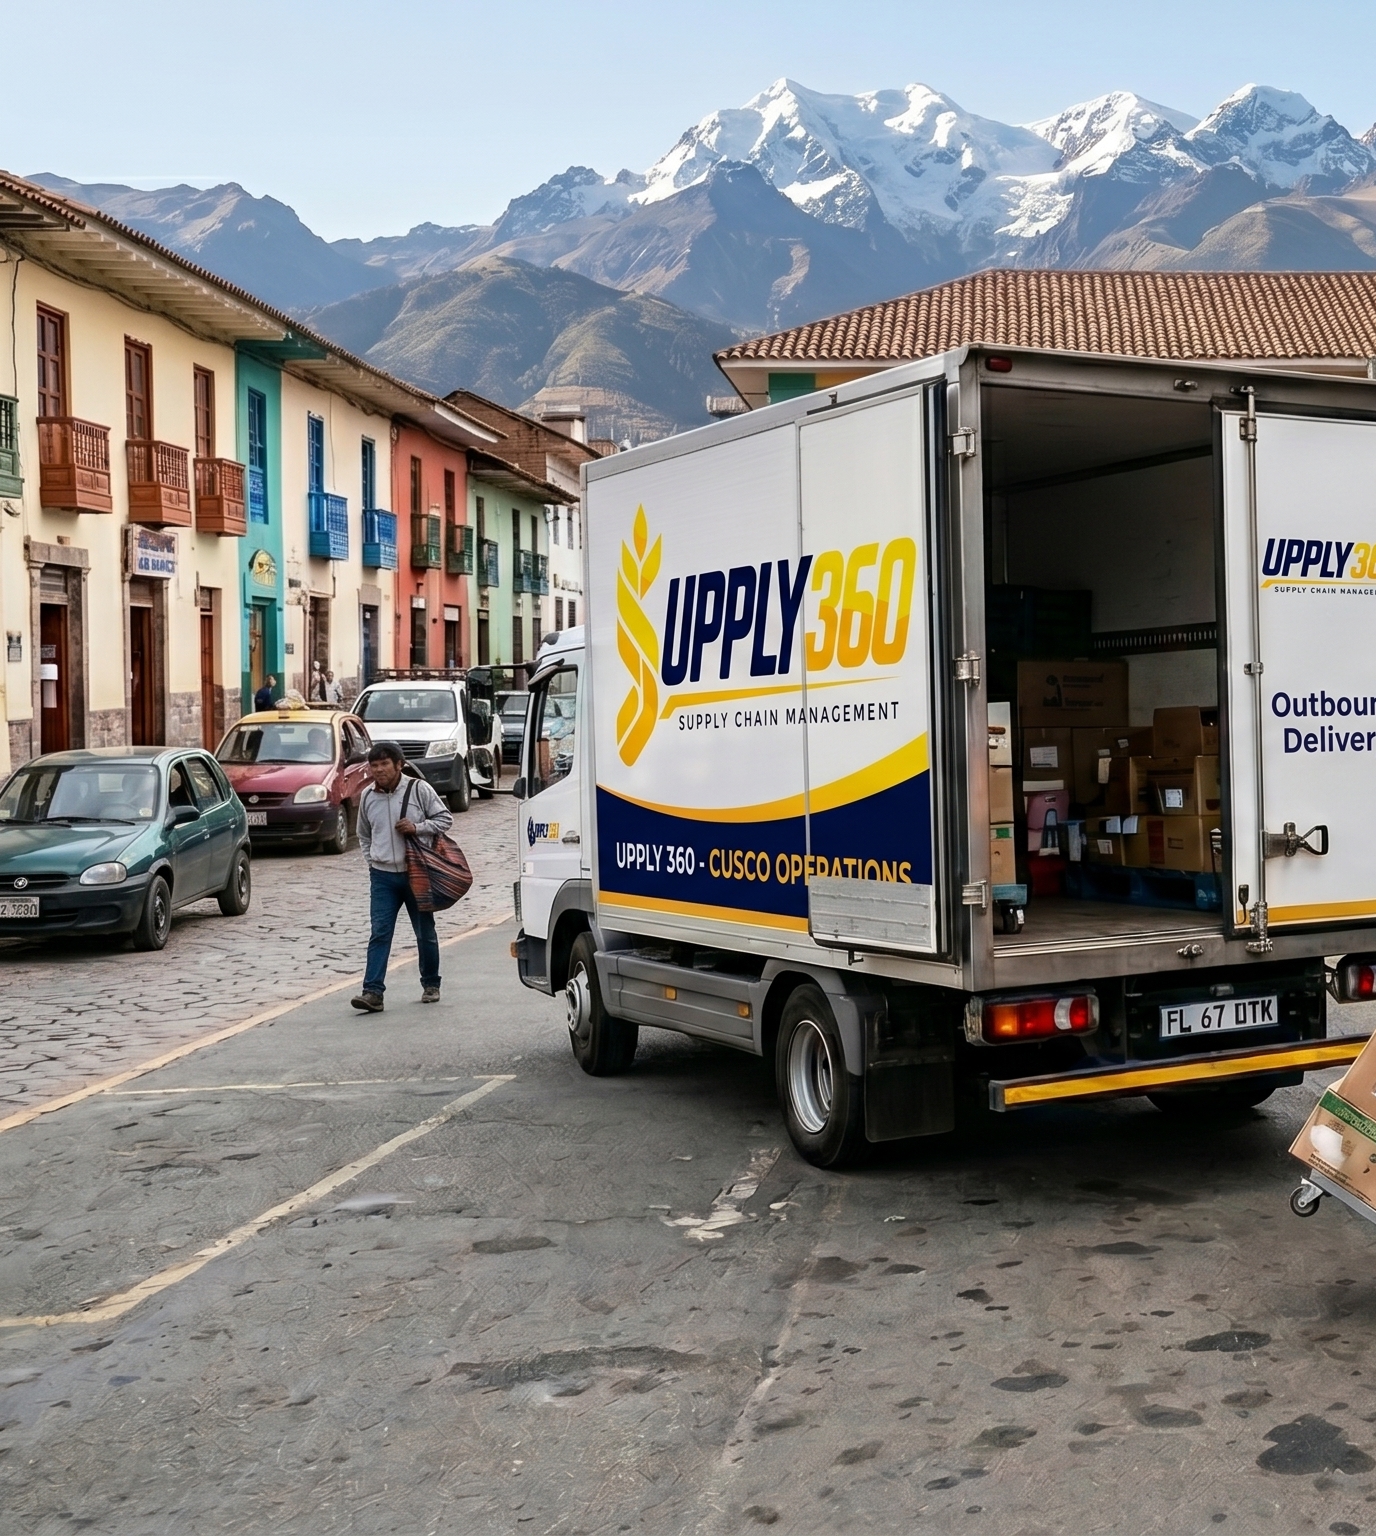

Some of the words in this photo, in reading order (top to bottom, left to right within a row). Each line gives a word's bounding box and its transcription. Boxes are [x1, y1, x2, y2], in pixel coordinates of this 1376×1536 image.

[1310, 587, 1337, 595] CHAIN
[678, 711, 728, 731] SUPPLY
[734, 708, 779, 728] CHAIN
[785, 700, 900, 725] MANAGEMENT
[616, 841, 662, 872] UPPLY
[666, 845, 695, 876] 360
[708, 848, 771, 883] CUSCO
[1167, 1008, 1192, 1035] FL
[1201, 1004, 1226, 1029] 67
